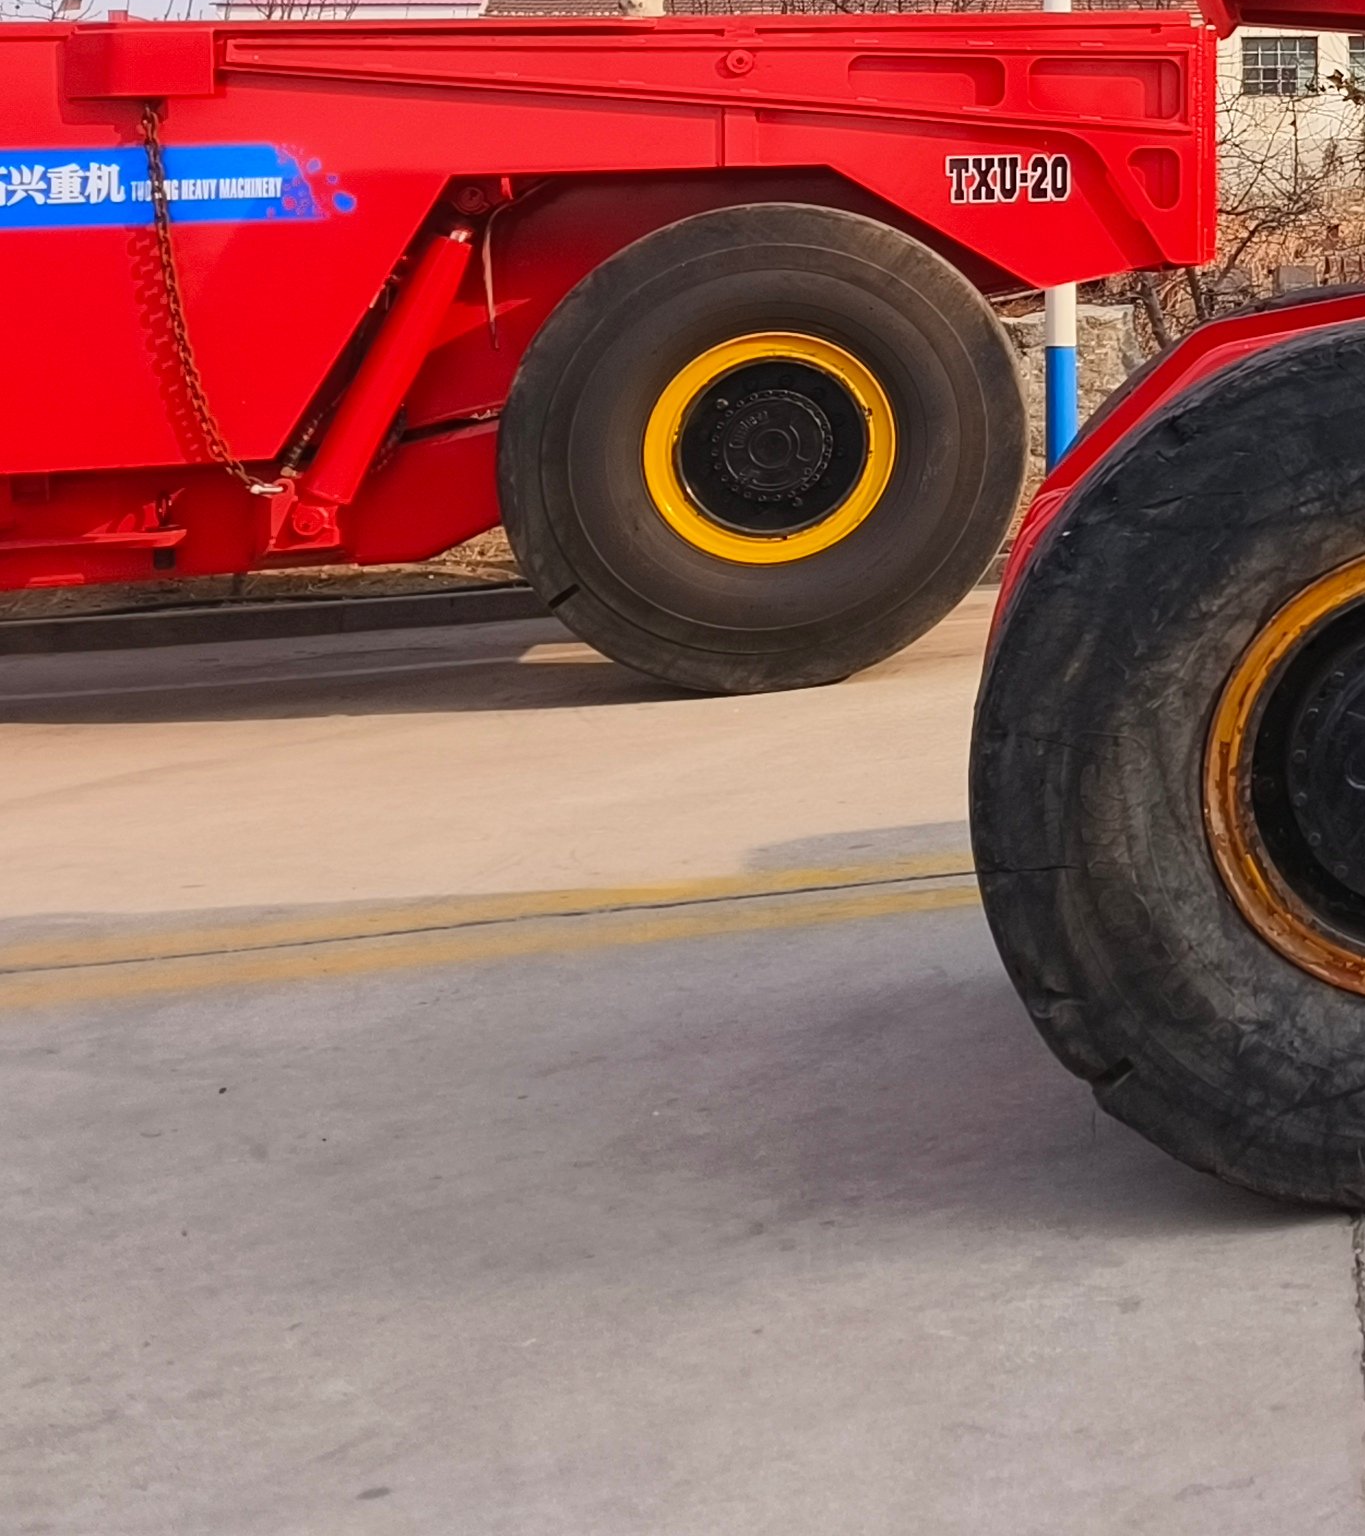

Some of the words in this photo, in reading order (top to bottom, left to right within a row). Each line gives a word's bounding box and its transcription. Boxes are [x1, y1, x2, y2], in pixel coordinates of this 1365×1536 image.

[0, 162, 126, 206] 兴重机
[181, 178, 217, 200] HEAVY
[219, 177, 283, 199] MACHINERY
[945, 153, 1071, 204] TXU-20
